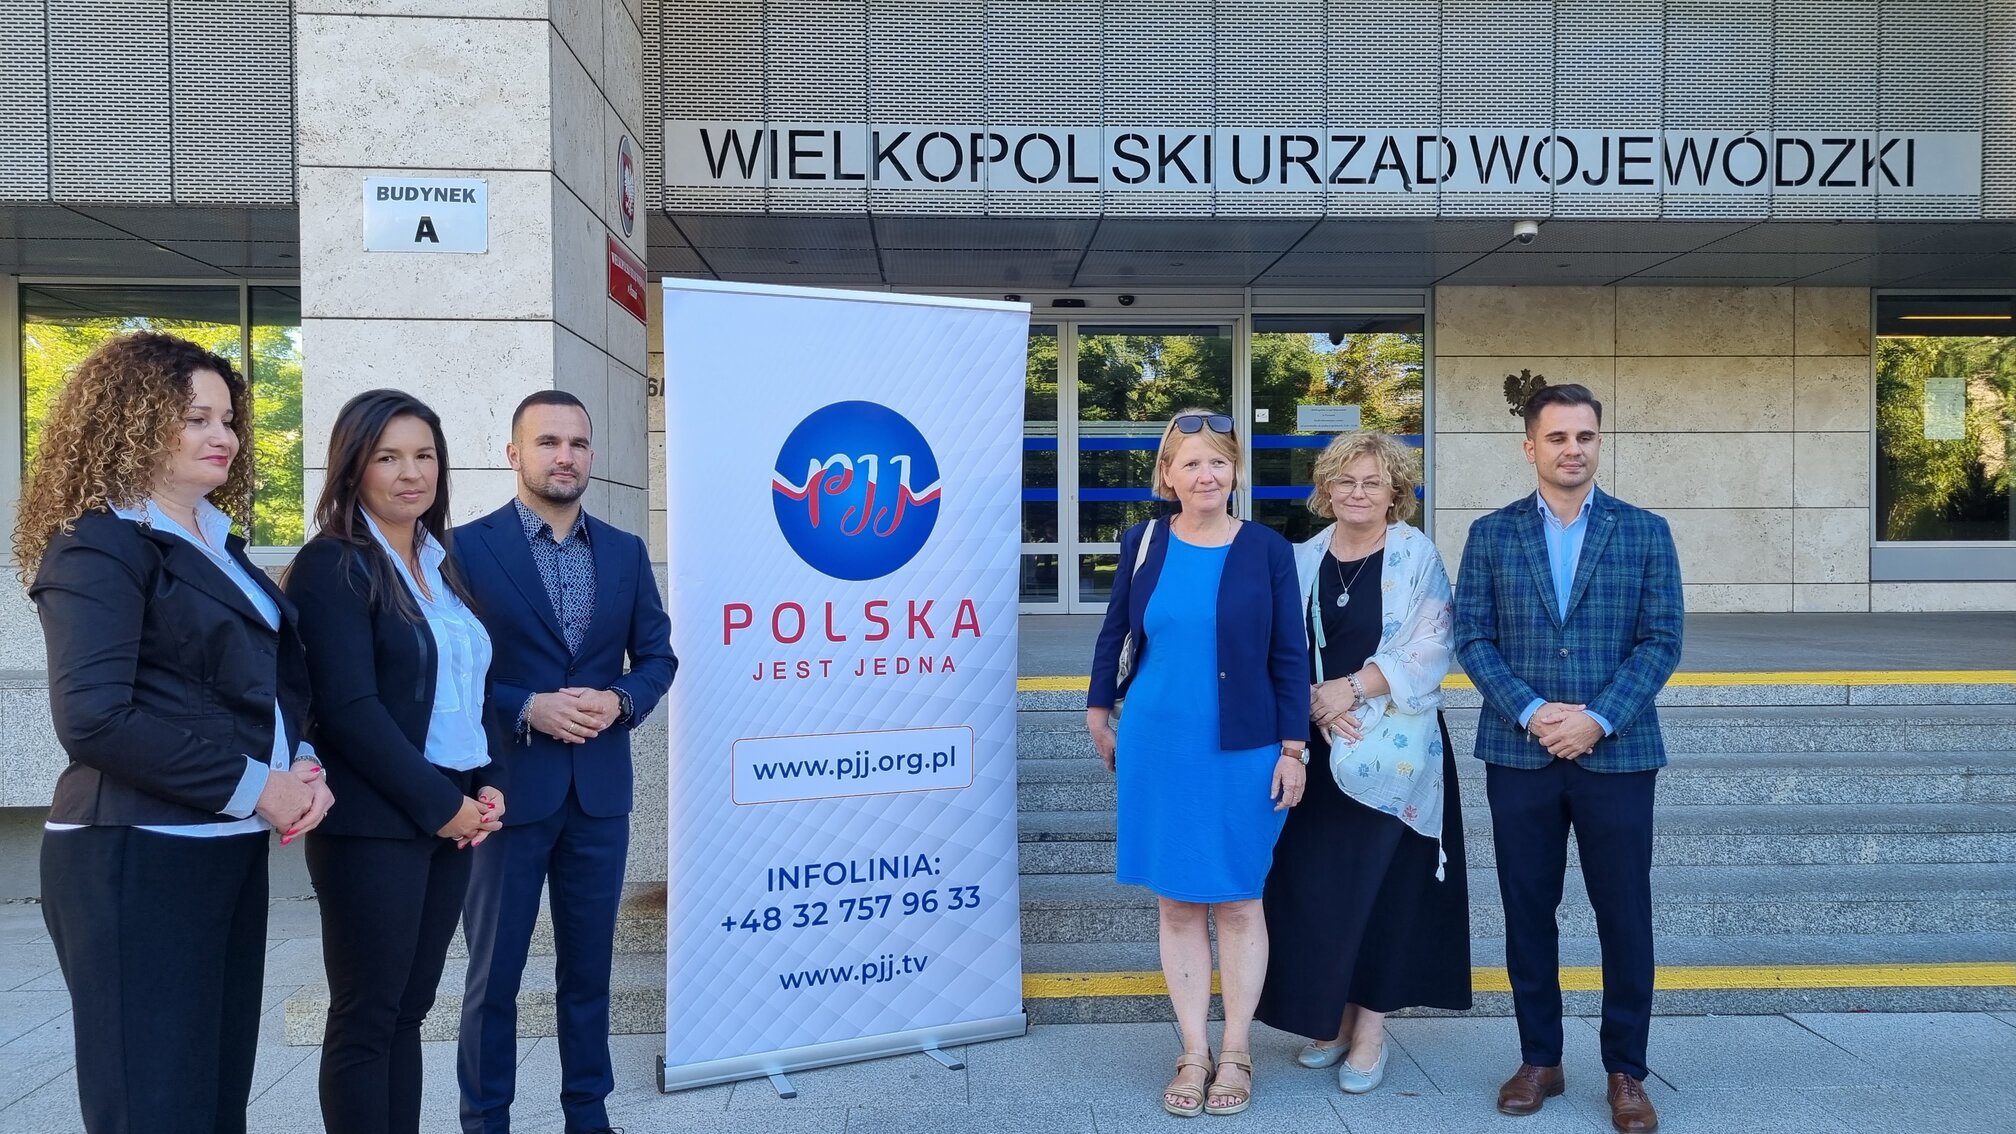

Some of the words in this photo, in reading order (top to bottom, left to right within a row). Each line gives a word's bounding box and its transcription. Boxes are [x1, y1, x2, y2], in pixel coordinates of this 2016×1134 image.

[699, 128, 1213, 185] WIELKOPOLSKI
[1231, 134, 1458, 192] URZĄD
[1467, 131, 1914, 188] WOJEWÓDZKI
[376, 186, 476, 203] BUDYNEK
[414, 216, 440, 243] A
[722, 598, 982, 646] POLSKA
[752, 659, 833, 681] JEST
[854, 655, 956, 677] JEDNA
[753, 745, 956, 780] www.pjj.org.pl
[766, 853, 941, 892] INFOLINIA:
[721, 907, 782, 933] +48
[792, 901, 829, 928] 32
[839, 894, 892, 922] 757
[902, 889, 939, 915] 96
[947, 885, 981, 911] 33
[779, 953, 928, 990] www.pjj.tv
